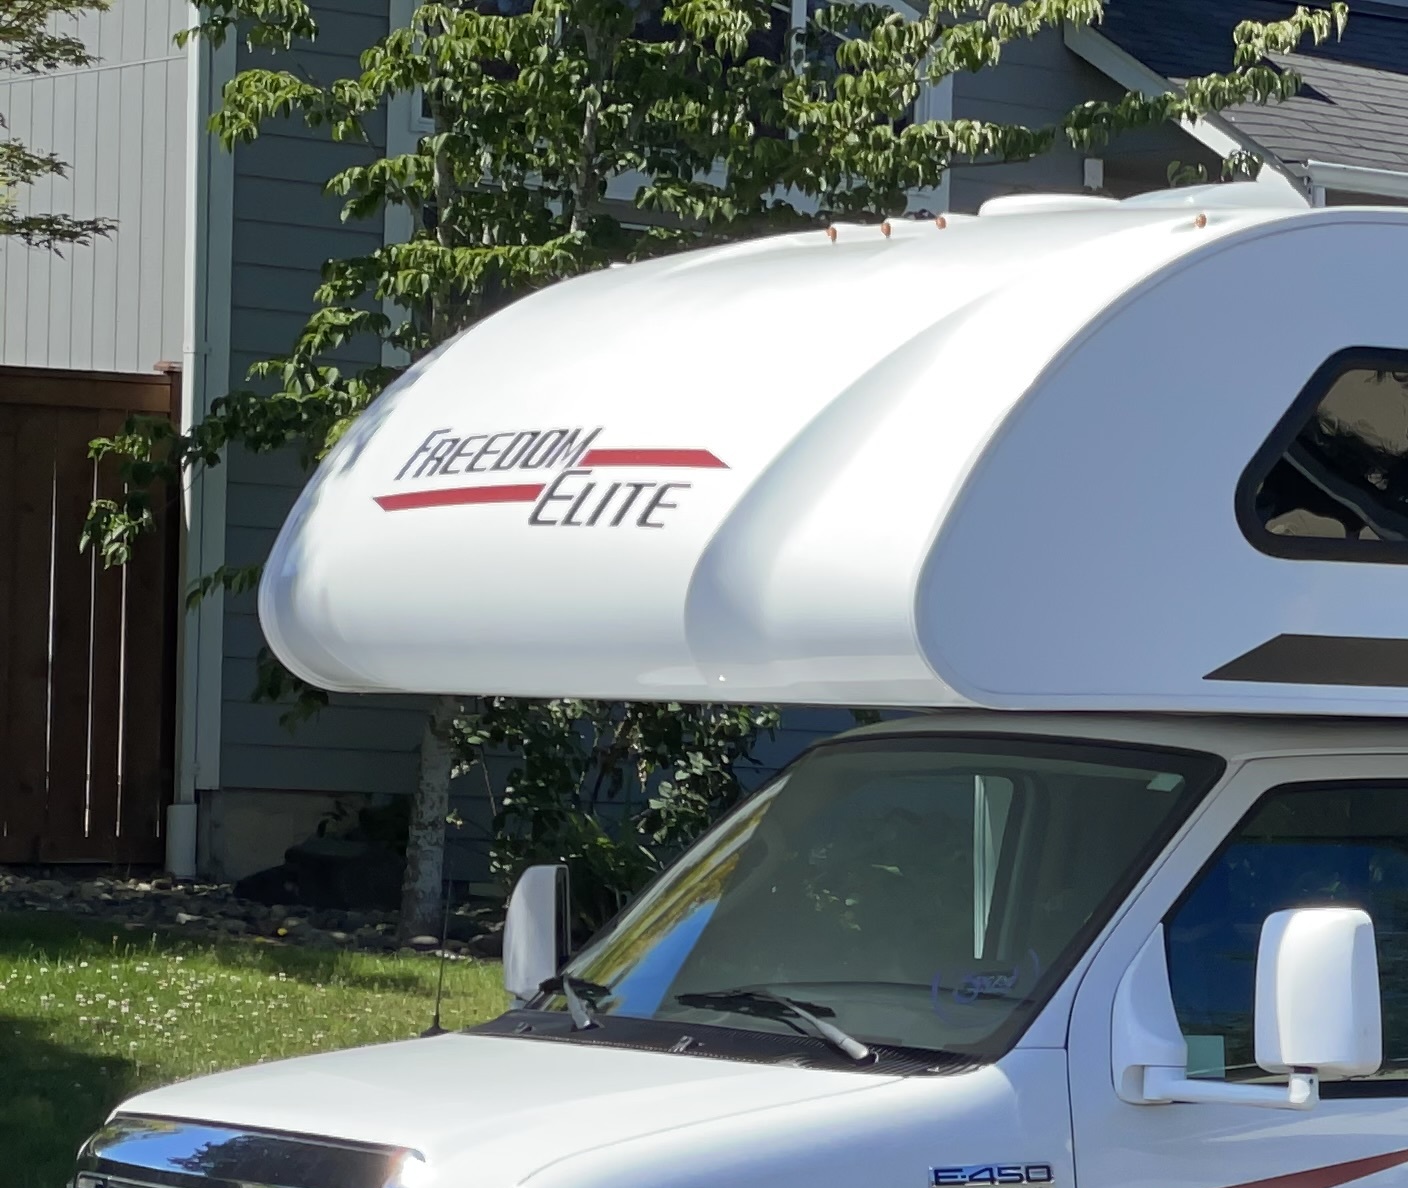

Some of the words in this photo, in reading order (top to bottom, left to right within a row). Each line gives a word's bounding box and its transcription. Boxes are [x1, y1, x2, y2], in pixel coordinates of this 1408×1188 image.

[394, 427, 603, 481] FREEDOM
[528, 470, 692, 528] ELITE
[933, 1164, 1053, 1186] E-450
